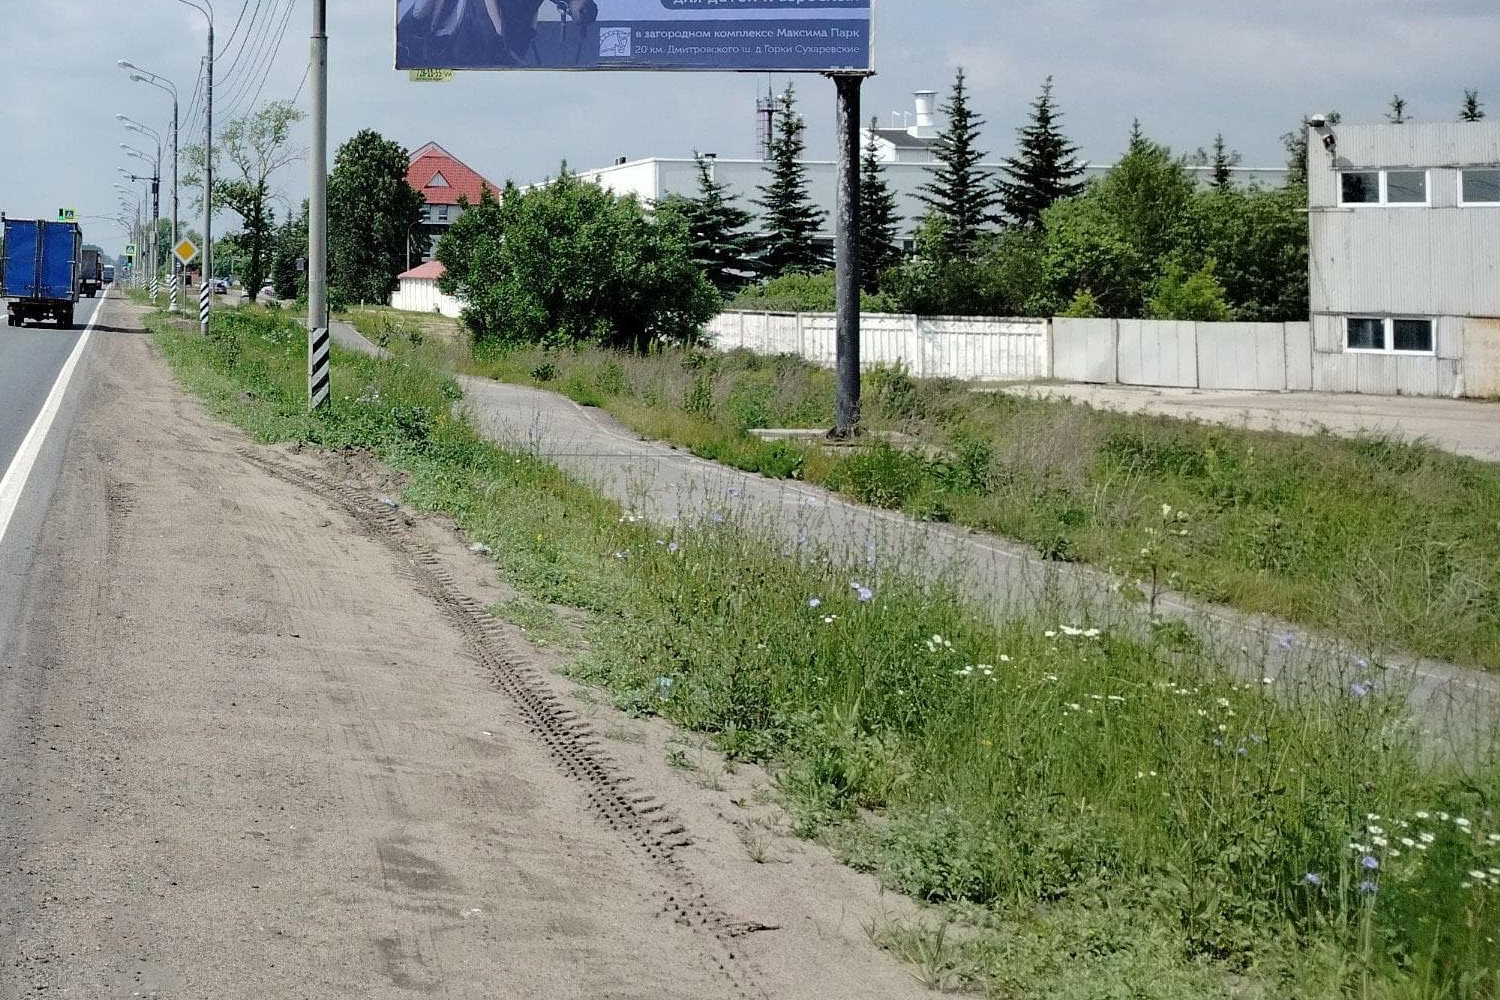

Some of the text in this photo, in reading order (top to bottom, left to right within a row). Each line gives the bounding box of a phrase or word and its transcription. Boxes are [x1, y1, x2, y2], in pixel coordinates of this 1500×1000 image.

[644, 30, 711, 40] загородном
[714, 30, 774, 39] комплексе
[776, 28, 828, 38] Максима
[830, 28, 860, 39] Парк
[635, 45, 648, 54] 20
[667, 45, 740, 55] Дмитровского
[794, 44, 860, 55] Сухаревские
